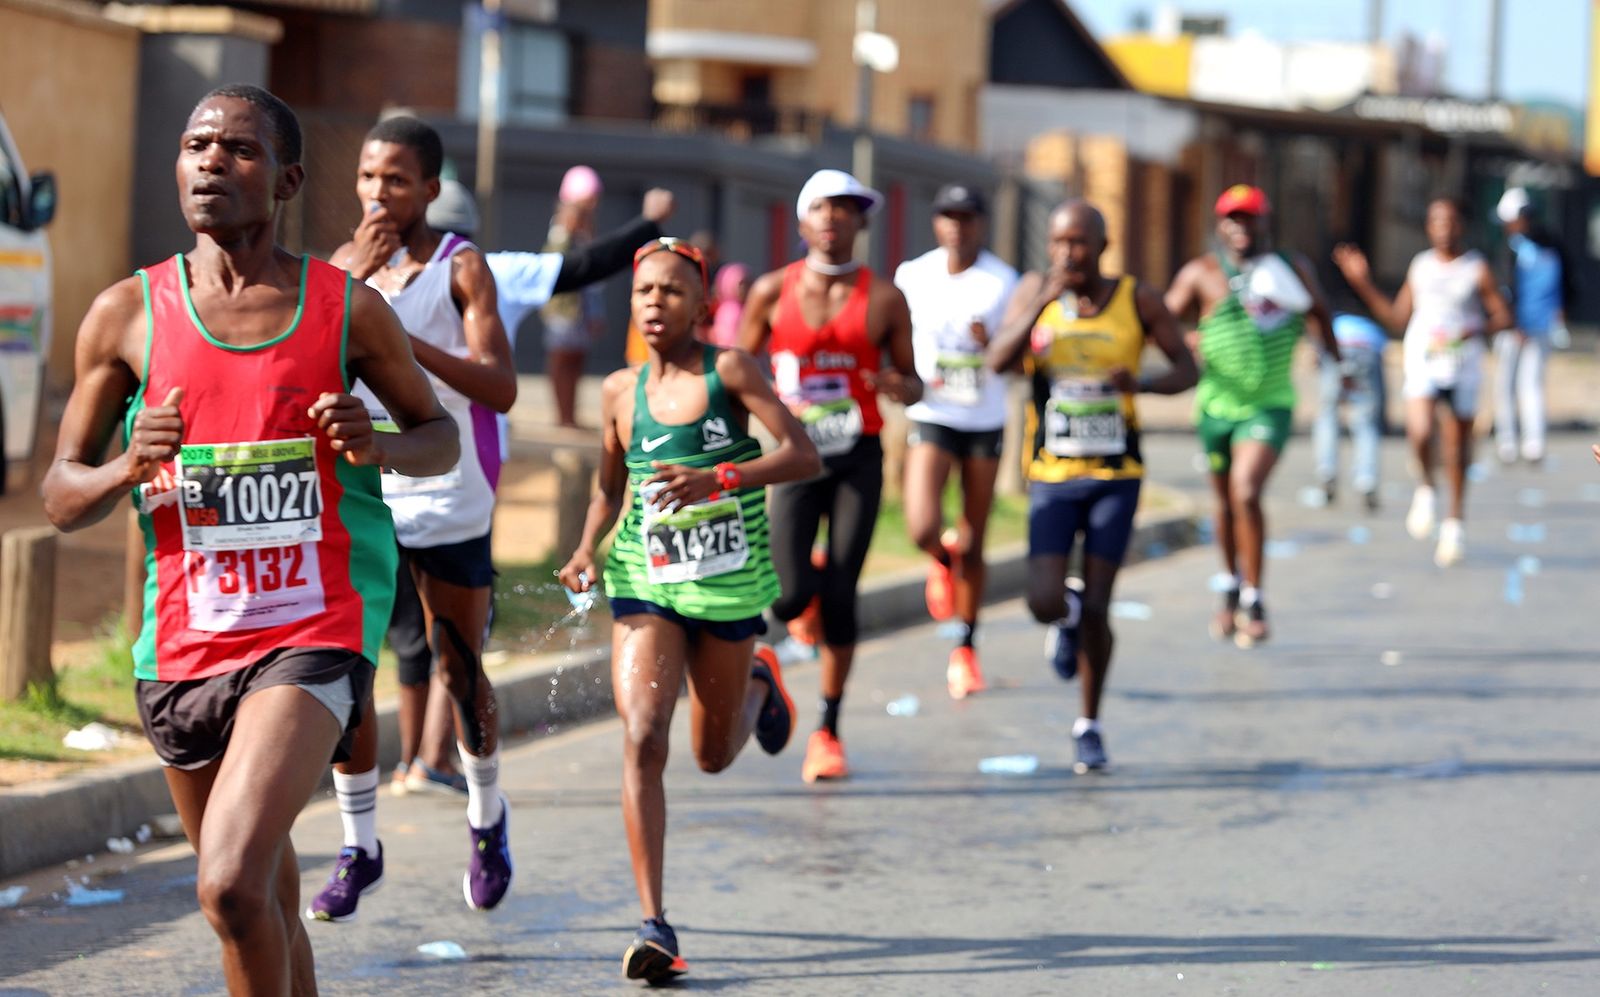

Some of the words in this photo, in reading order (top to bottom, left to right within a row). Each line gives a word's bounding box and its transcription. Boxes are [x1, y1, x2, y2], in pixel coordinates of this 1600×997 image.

[183, 480, 203, 502] B
[218, 472, 317, 523] 10027
[649, 534, 667, 555] A
[672, 519, 742, 562] 14275
[216, 544, 307, 594] 3132
